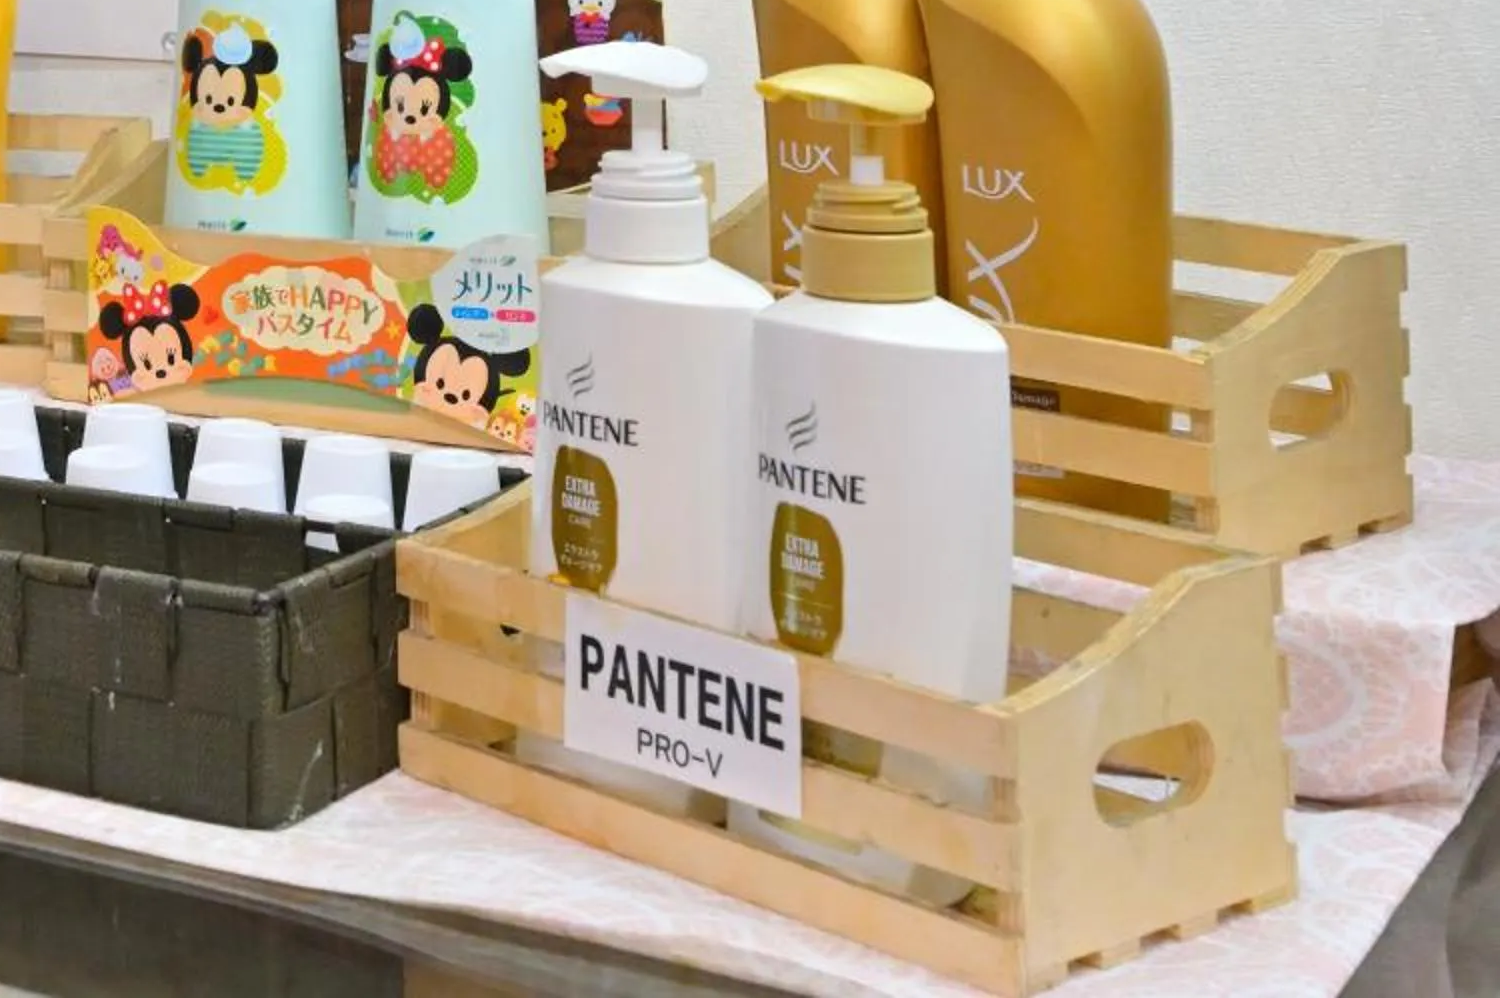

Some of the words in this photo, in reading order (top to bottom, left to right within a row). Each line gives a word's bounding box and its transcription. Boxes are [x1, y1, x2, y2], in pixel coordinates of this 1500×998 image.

[779, 139, 839, 176] LUX
[963, 165, 1034, 202] LUX
[452, 271, 532, 305] メリット
[257, 313, 351, 344] バスタイム
[543, 401, 639, 446] PANTENE
[758, 452, 866, 504] PANTENE
[581, 634, 785, 751] PANTENE
[637, 728, 723, 778] PRO-V
